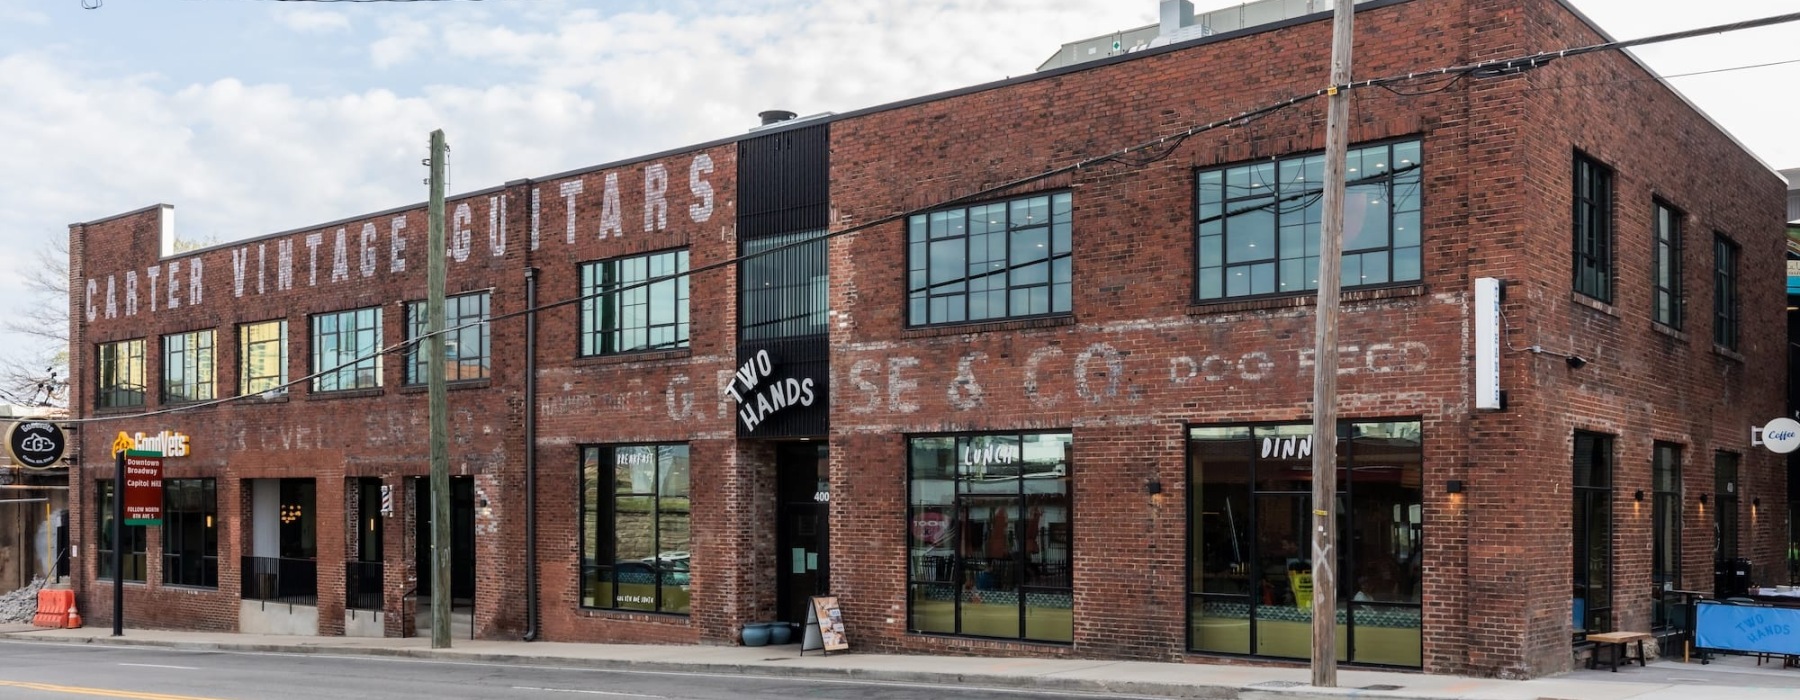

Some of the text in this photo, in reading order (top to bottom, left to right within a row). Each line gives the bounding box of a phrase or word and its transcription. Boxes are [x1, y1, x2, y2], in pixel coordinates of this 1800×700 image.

[86, 153, 715, 323] CARTER VINTAGE GUITARS
[724, 349, 772, 405] TWO
[1169, 351, 1274, 384] DOG
[947, 350, 987, 412] &
[739, 376, 815, 432] HANDS
[135, 431, 190, 457] GoodVets
[1261, 434, 1338, 460] DINN
[1768, 430, 1796, 441] Coffee
[127, 458, 160, 466] Downtown
[964, 443, 1013, 466] LUNCH
[127, 467, 158, 476] Broadway
[127, 480, 150, 488] Capitol
[814, 491, 830, 502] 400
[1735, 614, 1765, 633] TWO
[1747, 624, 1791, 644] HANDS
